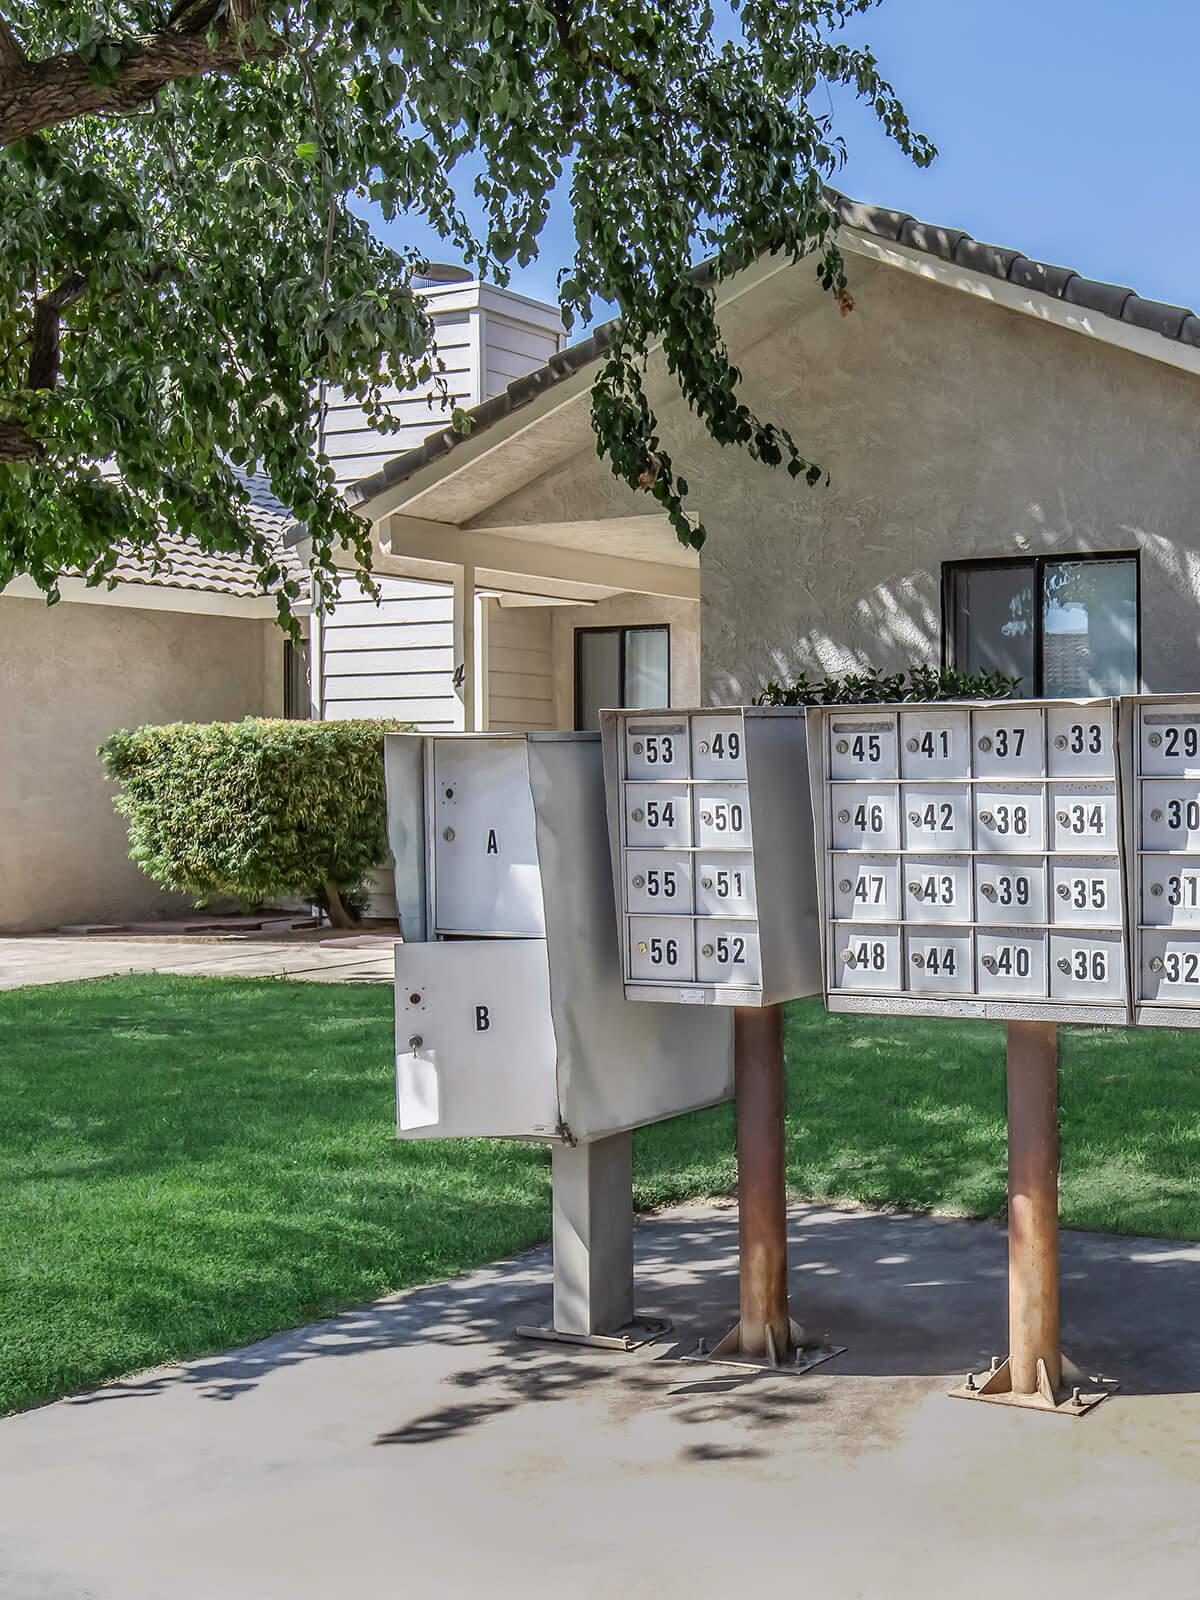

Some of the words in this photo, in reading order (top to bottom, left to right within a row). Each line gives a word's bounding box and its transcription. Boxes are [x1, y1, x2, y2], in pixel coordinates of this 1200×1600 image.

[646, 737, 674, 763] 53
[712, 733, 739, 759] 49
[852, 735, 880, 762] 45
[921, 731, 949, 758] 41
[996, 729, 1025, 757] 37
[1071, 725, 1101, 753] 33
[1165, 728, 1198, 757] 29
[647, 802, 674, 828] 54
[716, 805, 743, 831] 50
[854, 805, 883, 832] 46
[924, 804, 953, 831] 42
[997, 806, 1027, 834] 38
[1072, 805, 1103, 833] 34
[1168, 800, 1200, 830] 30
[487, 830, 497, 854] A
[647, 871, 676, 897] 55
[717, 872, 743, 897] 51
[855, 877, 884, 903] 47
[924, 877, 953, 904] 43
[1000, 877, 1029, 905] 39
[1074, 880, 1105, 908] 35
[1168, 877, 1197, 906] 31
[651, 939, 677, 965] 56
[717, 937, 745, 963] 52
[856, 943, 885, 970] 48
[927, 948, 956, 975] 44
[999, 948, 1029, 977] 40
[1075, 952, 1105, 980] 36
[1167, 953, 1199, 983] 32
[476, 1006, 489, 1031] B
